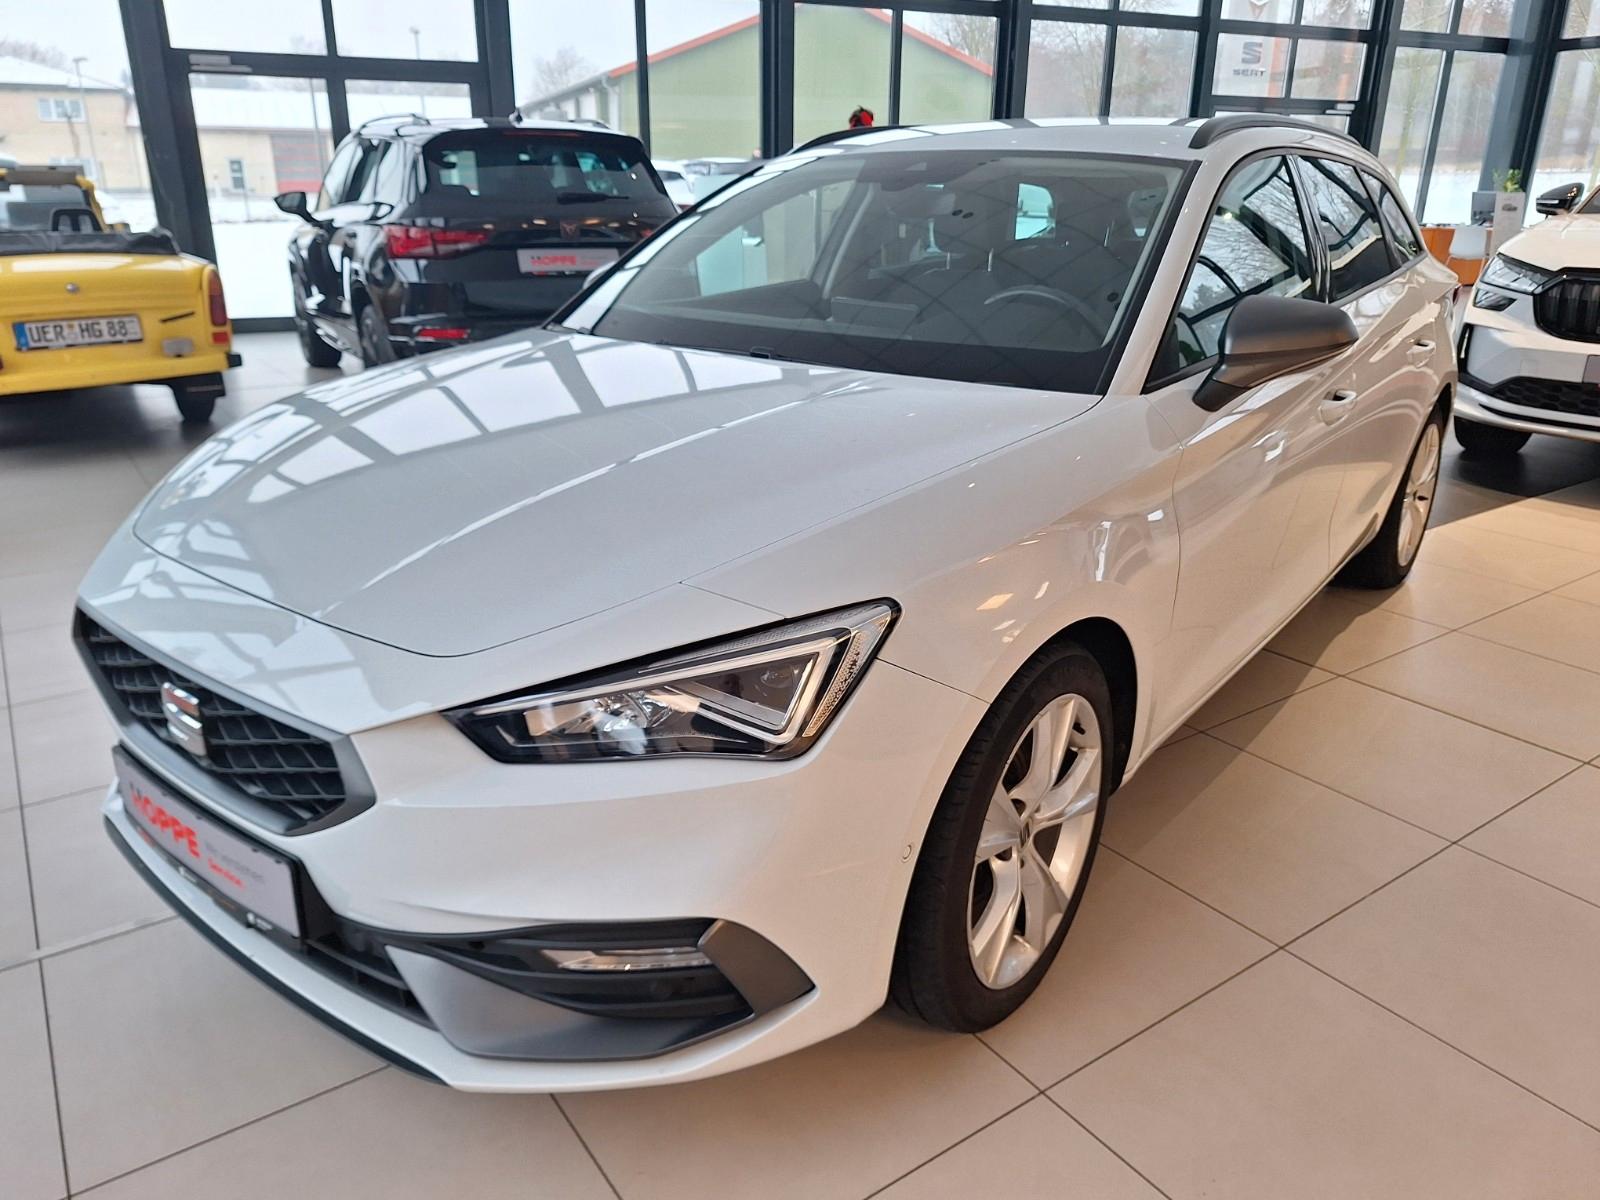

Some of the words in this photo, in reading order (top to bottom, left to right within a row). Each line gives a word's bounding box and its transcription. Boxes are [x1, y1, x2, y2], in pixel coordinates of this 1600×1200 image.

[1233, 68, 1266, 77] SEAT
[29, 324, 66, 343] UER
[78, 321, 103, 339] HG
[106, 320, 129, 338] 88
[130, 782, 200, 859] HOPPE
